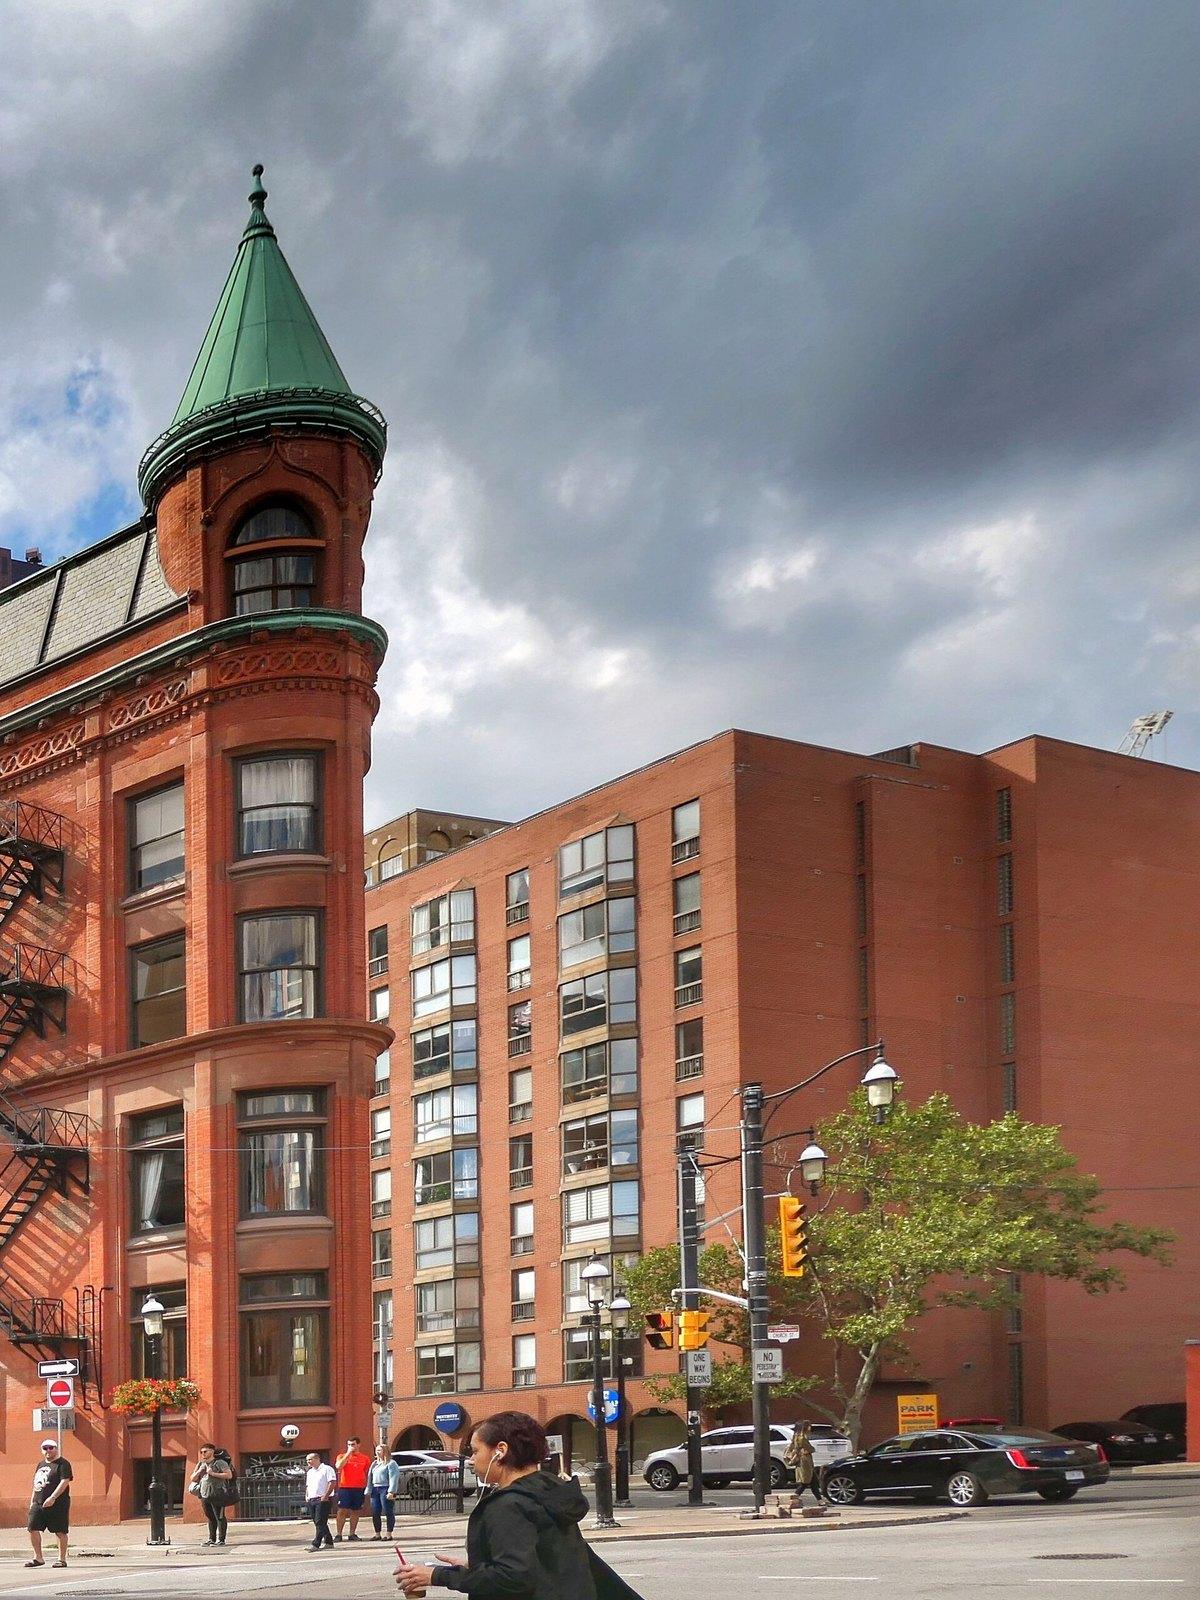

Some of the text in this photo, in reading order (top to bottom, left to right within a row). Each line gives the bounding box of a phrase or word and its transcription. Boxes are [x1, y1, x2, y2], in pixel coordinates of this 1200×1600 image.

[693, 1354, 706, 1362] ONE
[763, 1352, 774, 1362] NO
[694, 1364, 706, 1373] WAY
[689, 1375, 710, 1384] BEGINS
[901, 1404, 935, 1413] PARK
